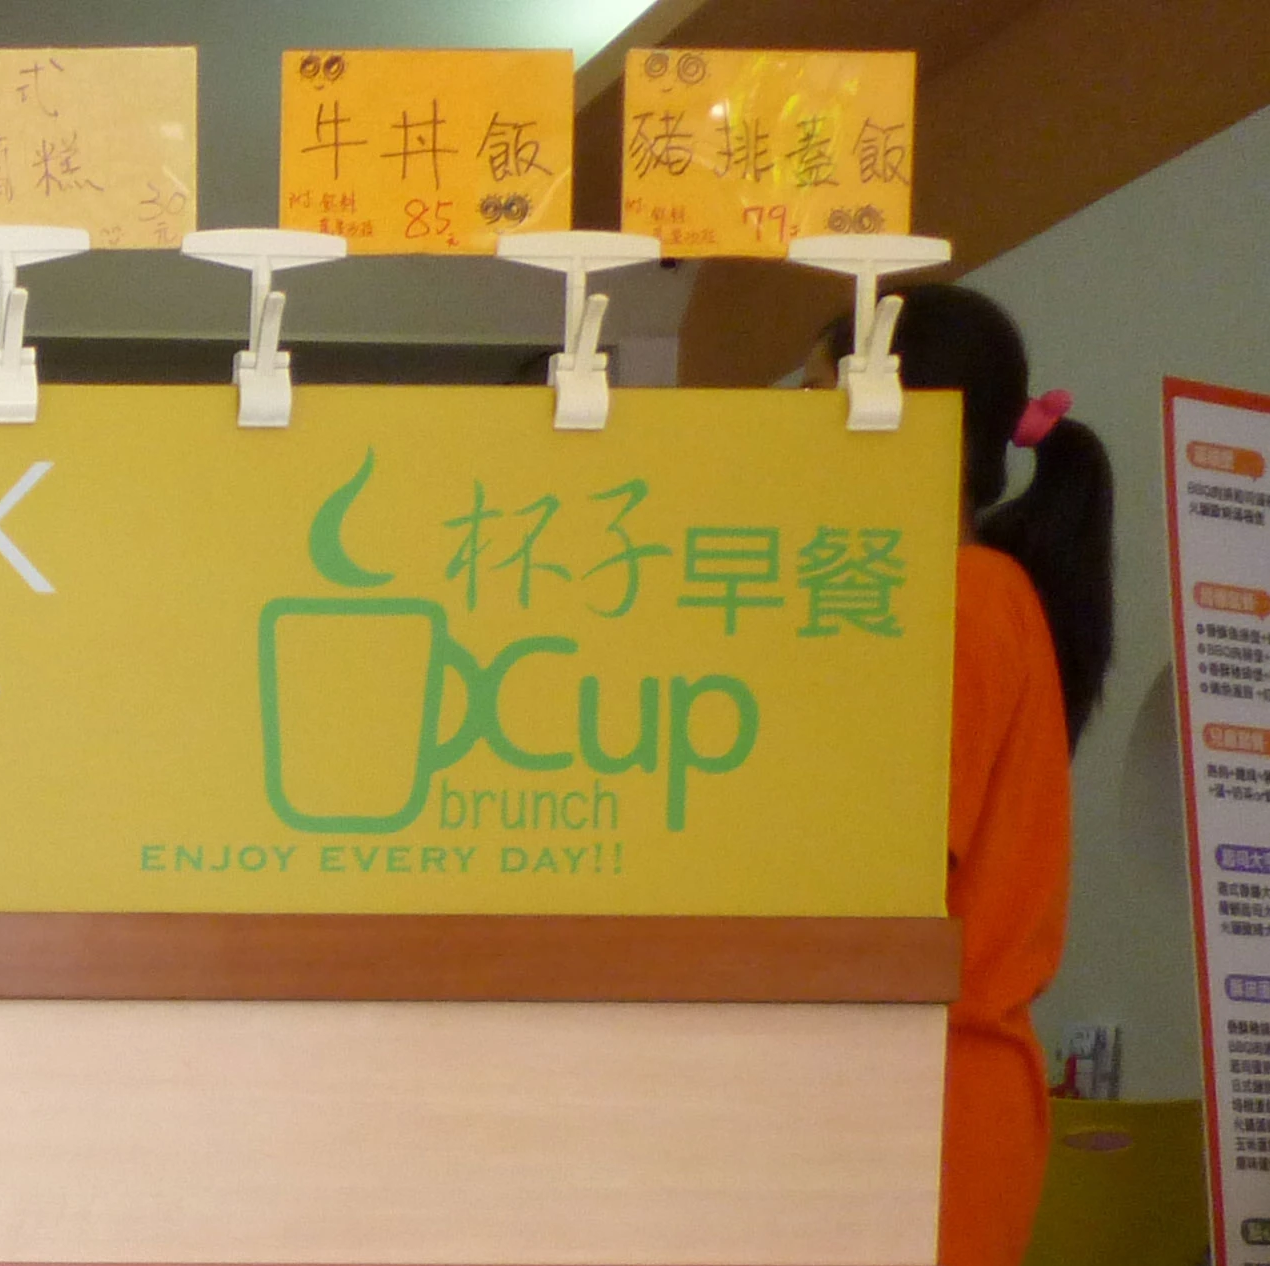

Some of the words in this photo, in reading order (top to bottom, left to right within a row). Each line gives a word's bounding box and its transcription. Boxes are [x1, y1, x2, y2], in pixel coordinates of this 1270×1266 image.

[300, 96, 555, 191] 牛丼飯
[629, 100, 910, 190] 豬排蓋飯
[403, 198, 455, 240] 85
[441, 477, 907, 638] 杯子早餐
[474, 635, 759, 833] Cup
[440, 779, 620, 832] brunch
[139, 844, 297, 874] ENJOY
[318, 844, 478, 875] EVERY
